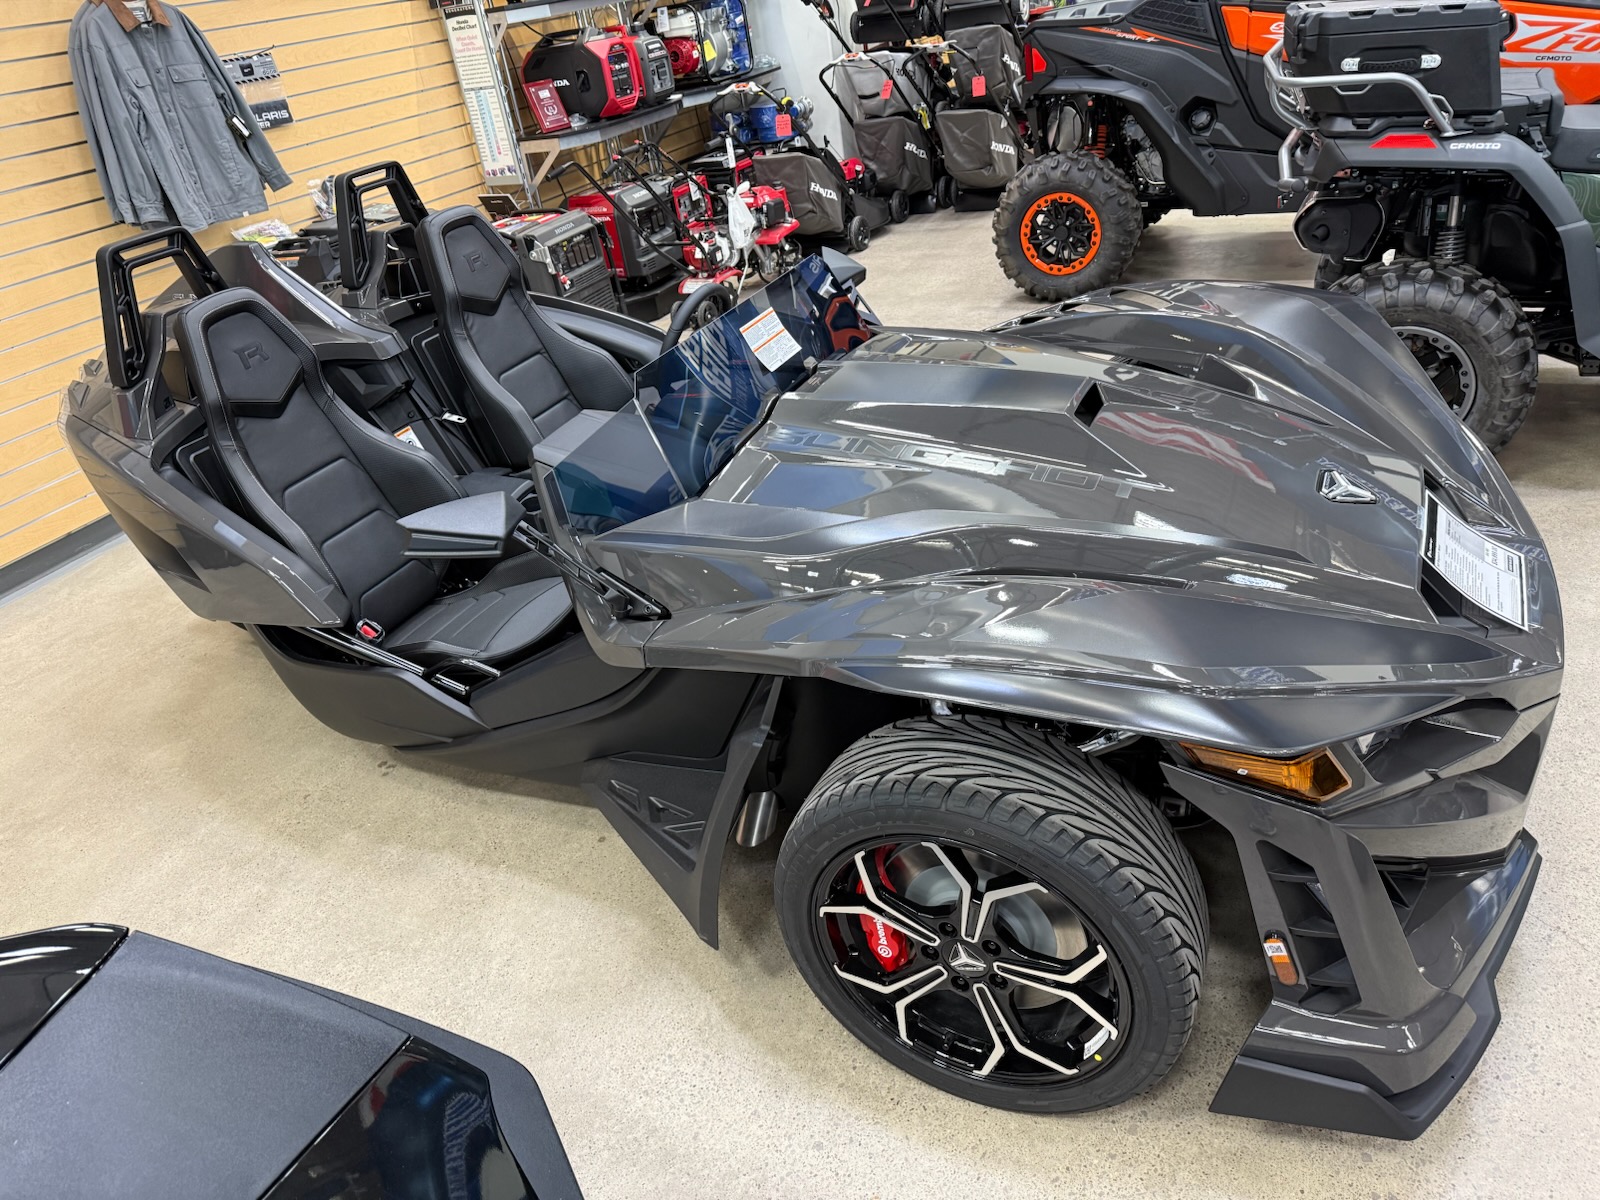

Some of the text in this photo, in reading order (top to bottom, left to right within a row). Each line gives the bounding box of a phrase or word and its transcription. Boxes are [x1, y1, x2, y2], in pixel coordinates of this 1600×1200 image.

[255, 109, 289, 122] LARIS
[1450, 142, 1502, 150] CFMOTO
[554, 222, 575, 235] HONDA
[764, 421, 1157, 499] SLINGSHOT
